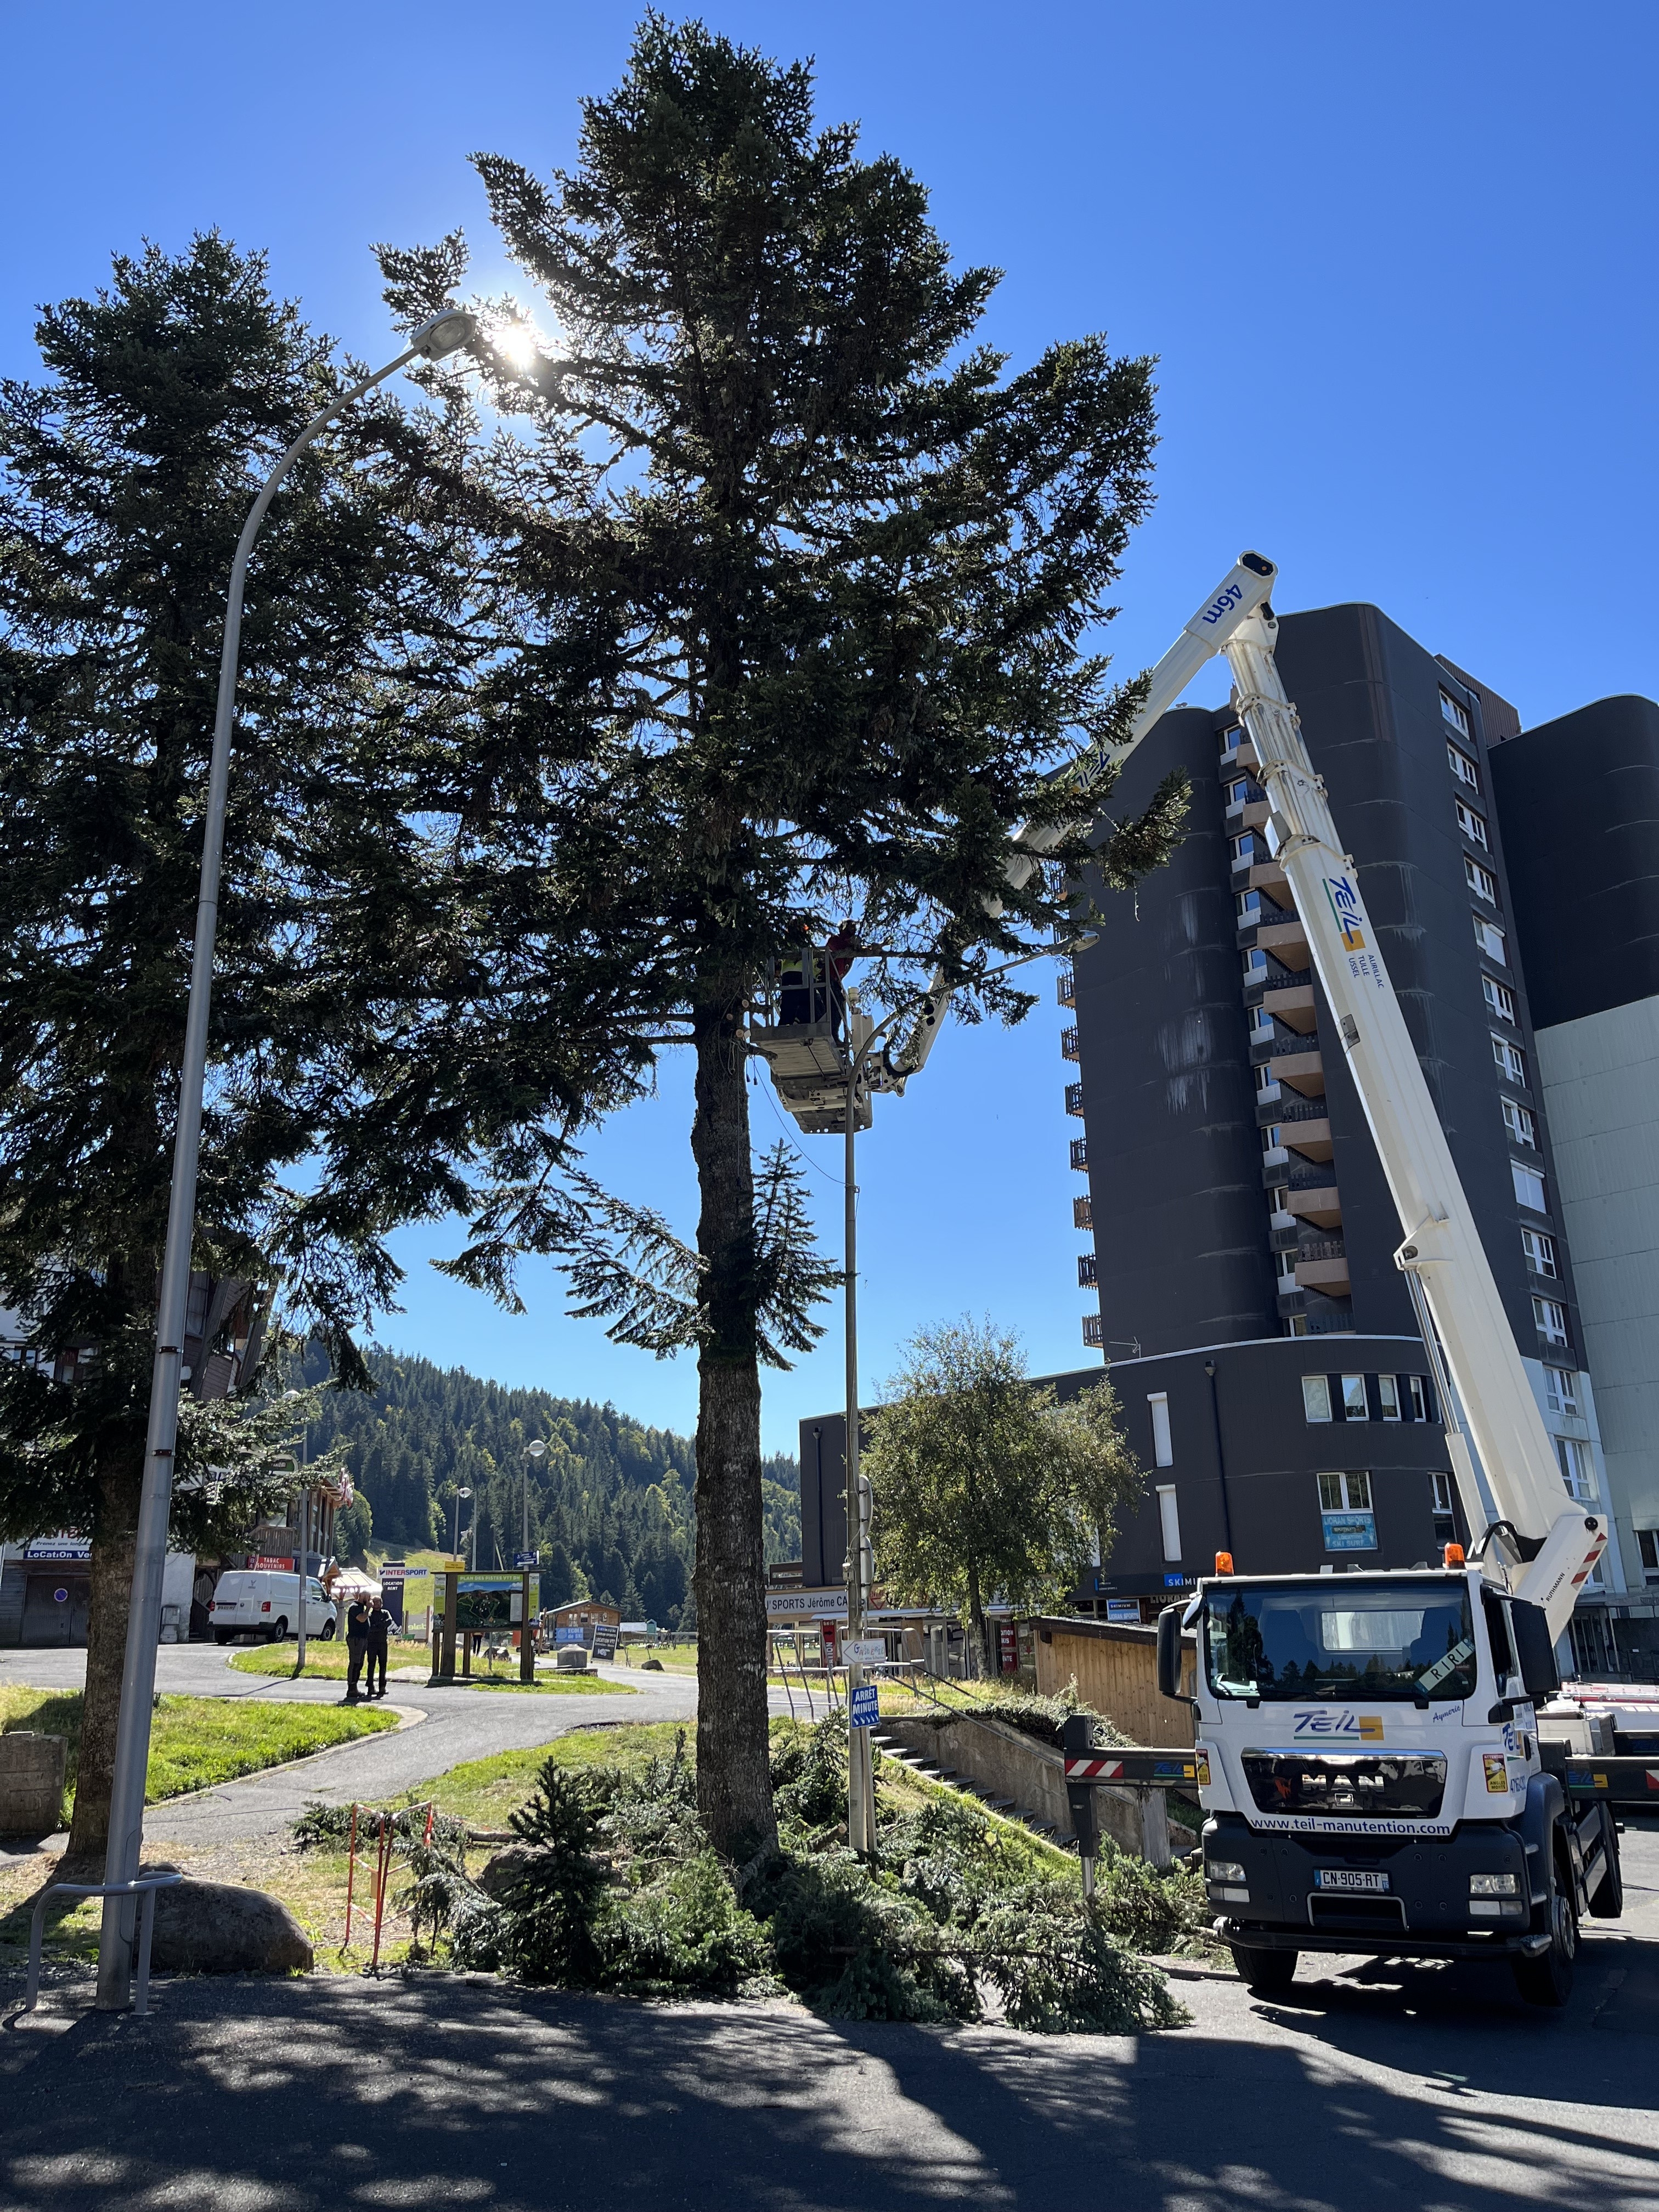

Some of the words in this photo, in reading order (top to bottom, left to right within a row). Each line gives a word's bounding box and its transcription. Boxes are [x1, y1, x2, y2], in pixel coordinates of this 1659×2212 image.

[1202, 584, 1243, 624] 46m
[1329, 876, 1362, 944] TEIL
[1348, 957, 1360, 978] USSEL
[1358, 955, 1370, 976] TULLE
[1368, 954, 1384, 989] AURILLAC
[1346, 1516, 1372, 1525] SPORTS
[1168, 1578, 1196, 1587] SKIMI
[1546, 1572, 1565, 1602] RUTHMANN
[808, 1596, 834, 1608] Jérôme
[855, 1686, 875, 1702] ARRÊT
[853, 1700, 878, 1714] MINUTE
[1433, 1706, 1460, 1723] Aymeric
[1294, 1710, 1375, 1733] TEIL
[1154, 1762, 1190, 1774] TEIL
[1302, 1774, 1385, 1792] MAN
[1251, 1818, 1450, 1835] www.teil-manutention.com
